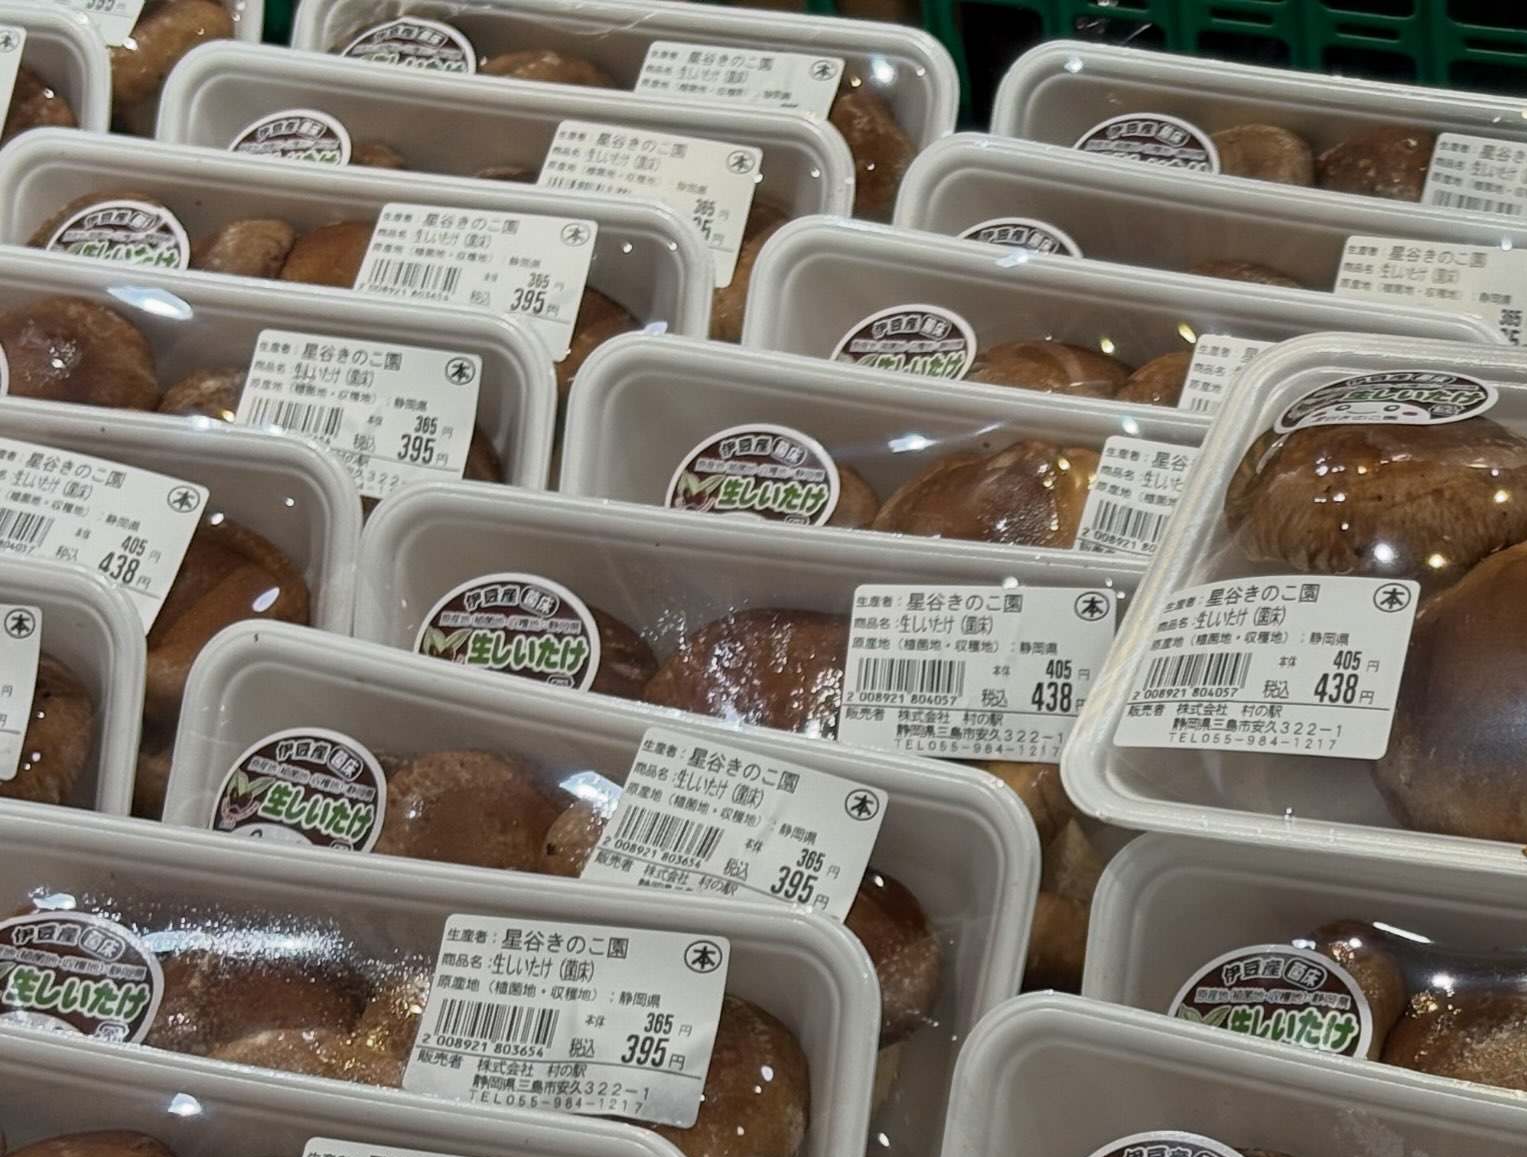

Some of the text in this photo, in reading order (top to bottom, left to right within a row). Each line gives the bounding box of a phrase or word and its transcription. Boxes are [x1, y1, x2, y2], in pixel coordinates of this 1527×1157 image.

[715, 476, 829, 517] 生しいたけ
[465, 629, 590, 676] 生しいたけ
[258, 780, 374, 844] 生しいたけ
[2, 965, 150, 1023] 生しいたけ
[1229, 1005, 1359, 1053] 生しいたけ
